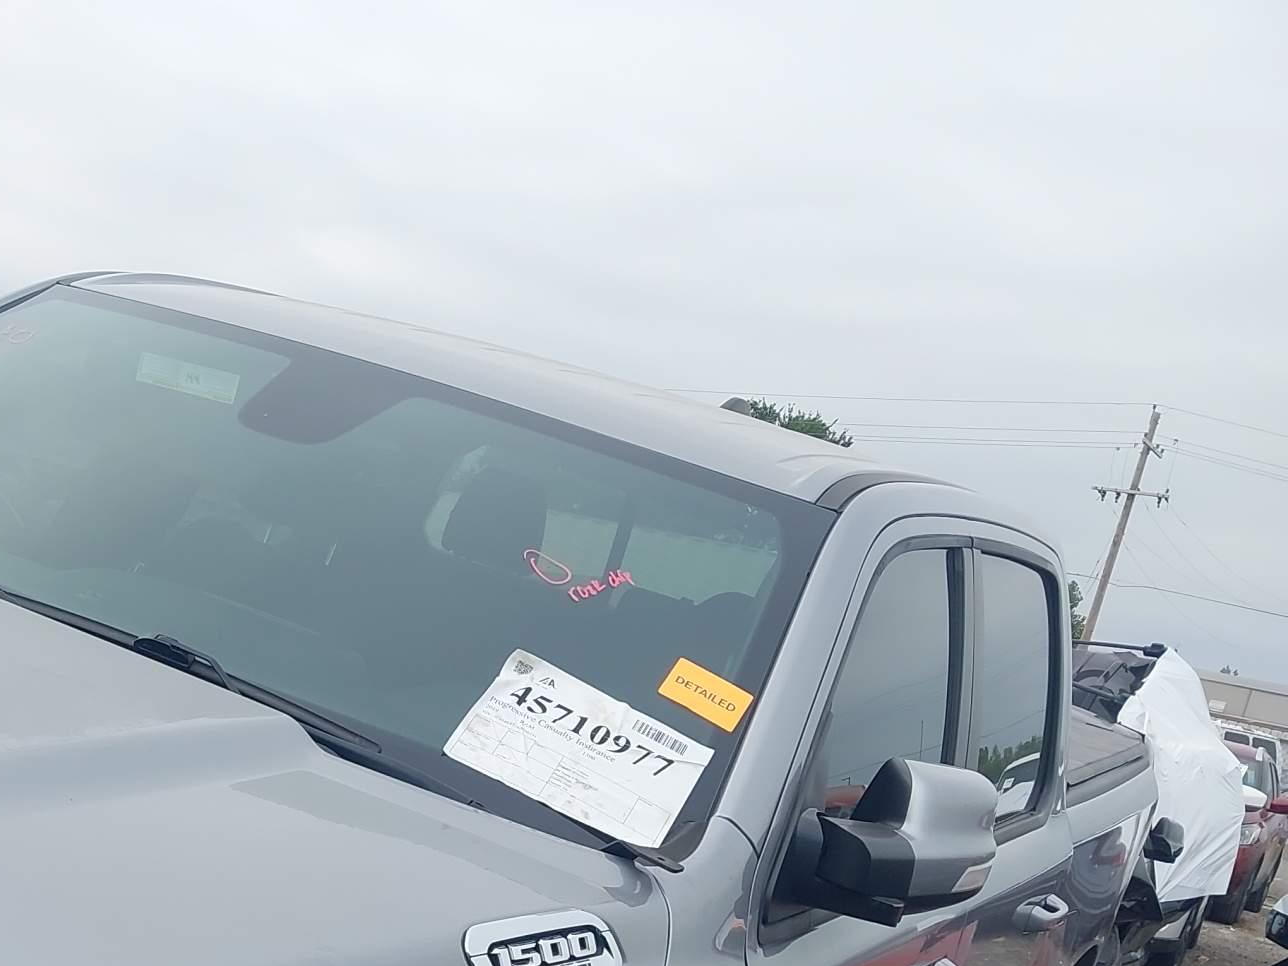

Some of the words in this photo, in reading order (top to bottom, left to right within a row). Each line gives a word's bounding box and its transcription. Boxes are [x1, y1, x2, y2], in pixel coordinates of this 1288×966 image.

[675, 674, 737, 714] DETAILED
[489, 695, 537, 723] Progressive
[538, 719, 573, 742] Casualty
[575, 737, 616, 762] Insurance
[509, 685, 676, 777] 45710977
